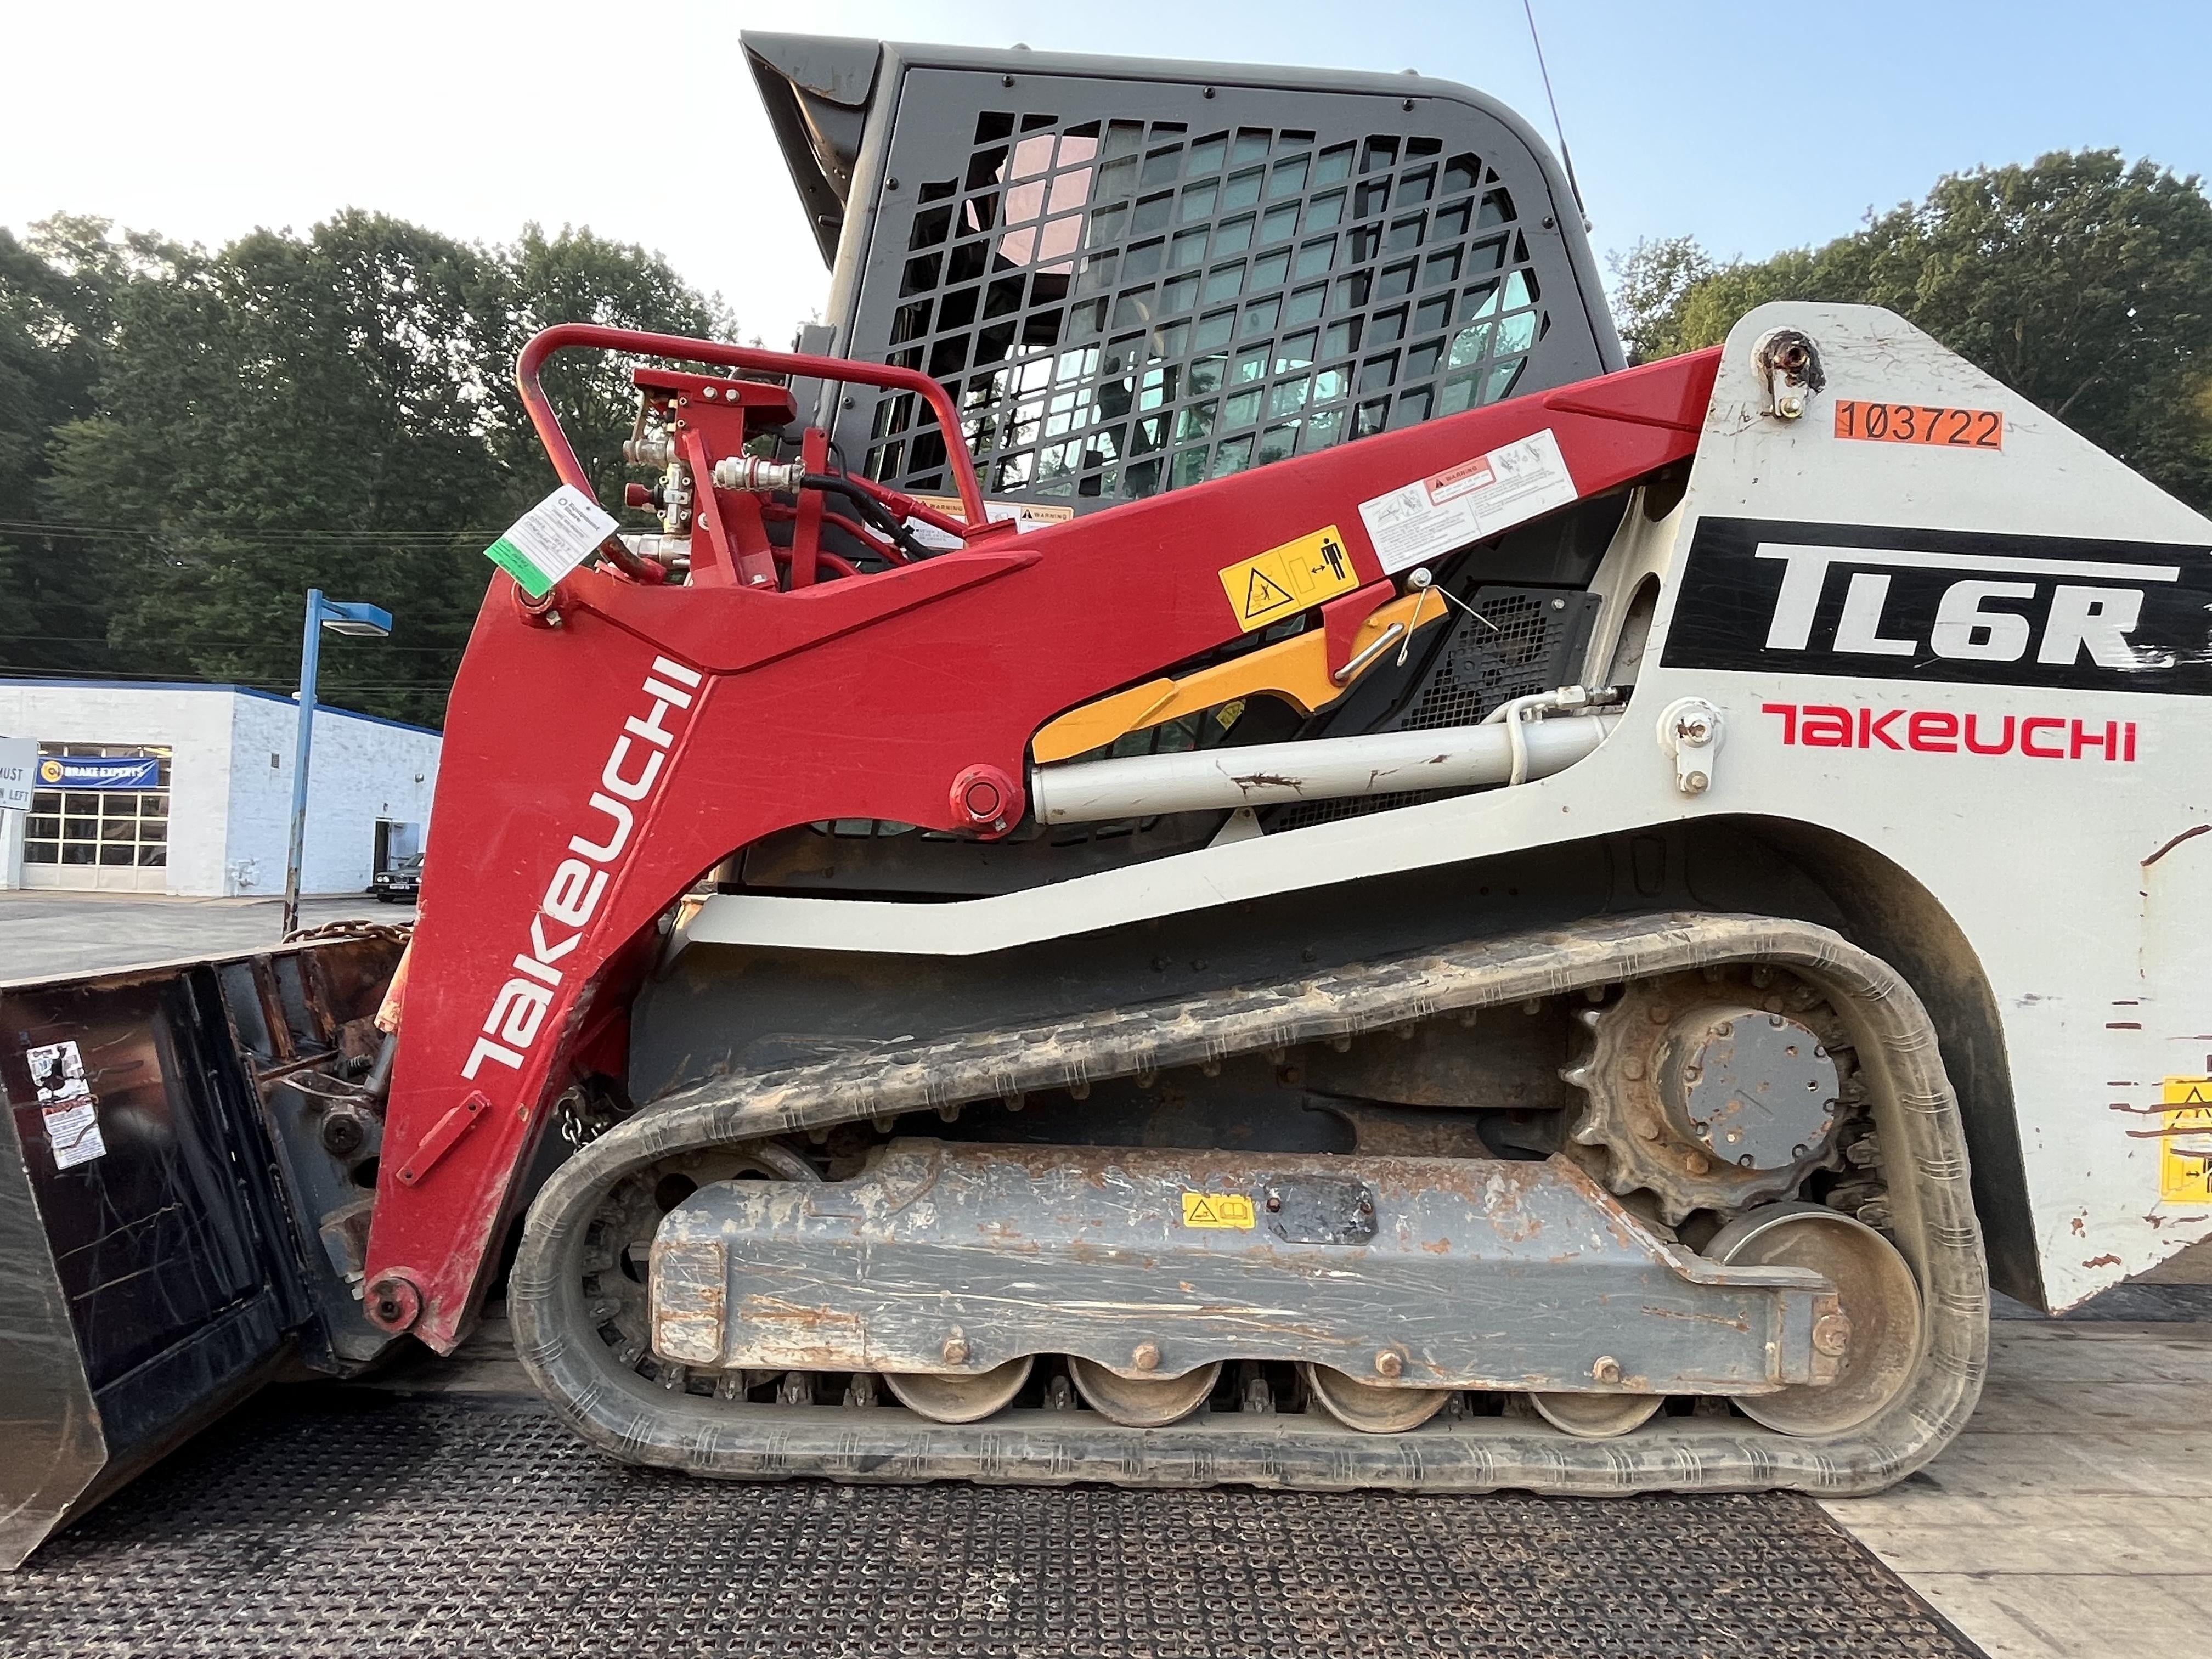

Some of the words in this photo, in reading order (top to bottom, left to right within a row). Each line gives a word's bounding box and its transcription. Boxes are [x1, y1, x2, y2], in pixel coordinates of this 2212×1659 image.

[1841, 402, 1999, 446] 103722
[1446, 465, 1478, 482] WARNING
[1755, 543, 2180, 668] TL6R
[65, 766, 99, 777] BRAKE
[9, 789, 29, 802] LEFT
